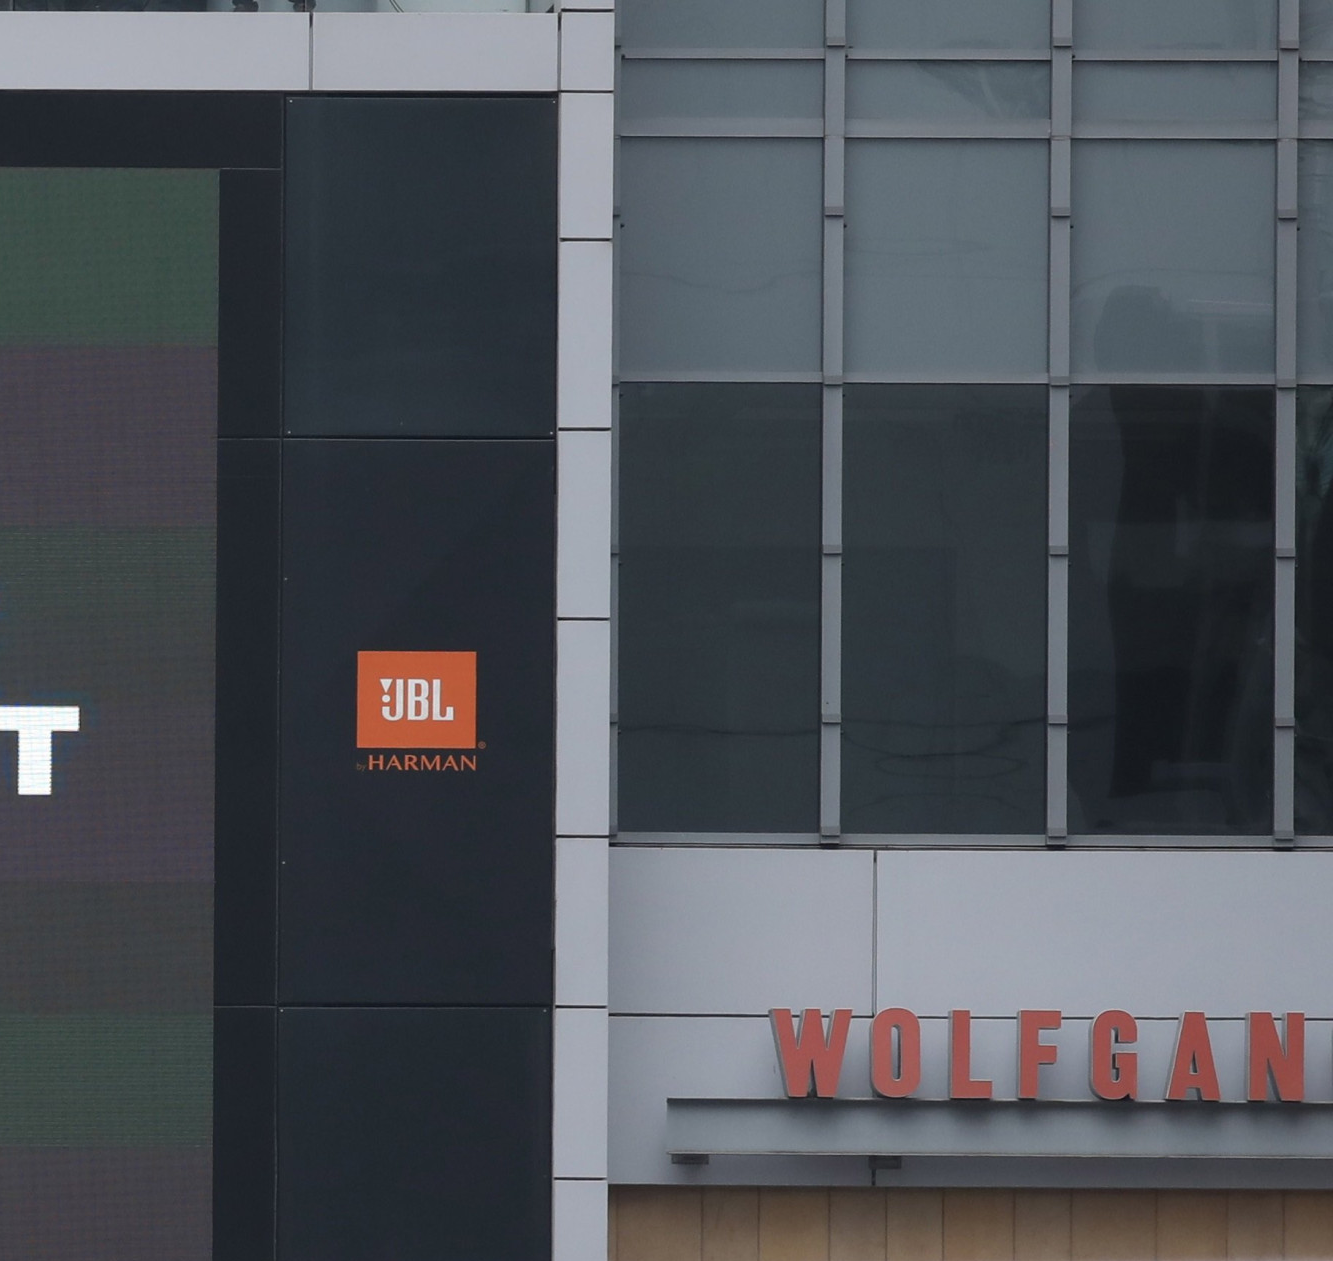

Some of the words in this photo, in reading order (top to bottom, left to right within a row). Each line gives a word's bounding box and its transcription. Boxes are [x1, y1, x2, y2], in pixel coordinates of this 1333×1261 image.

[379, 678, 454, 721] JBL
[368, 754, 477, 771] HARMAN
[767, 1006, 1306, 1102] WOLFGAN
